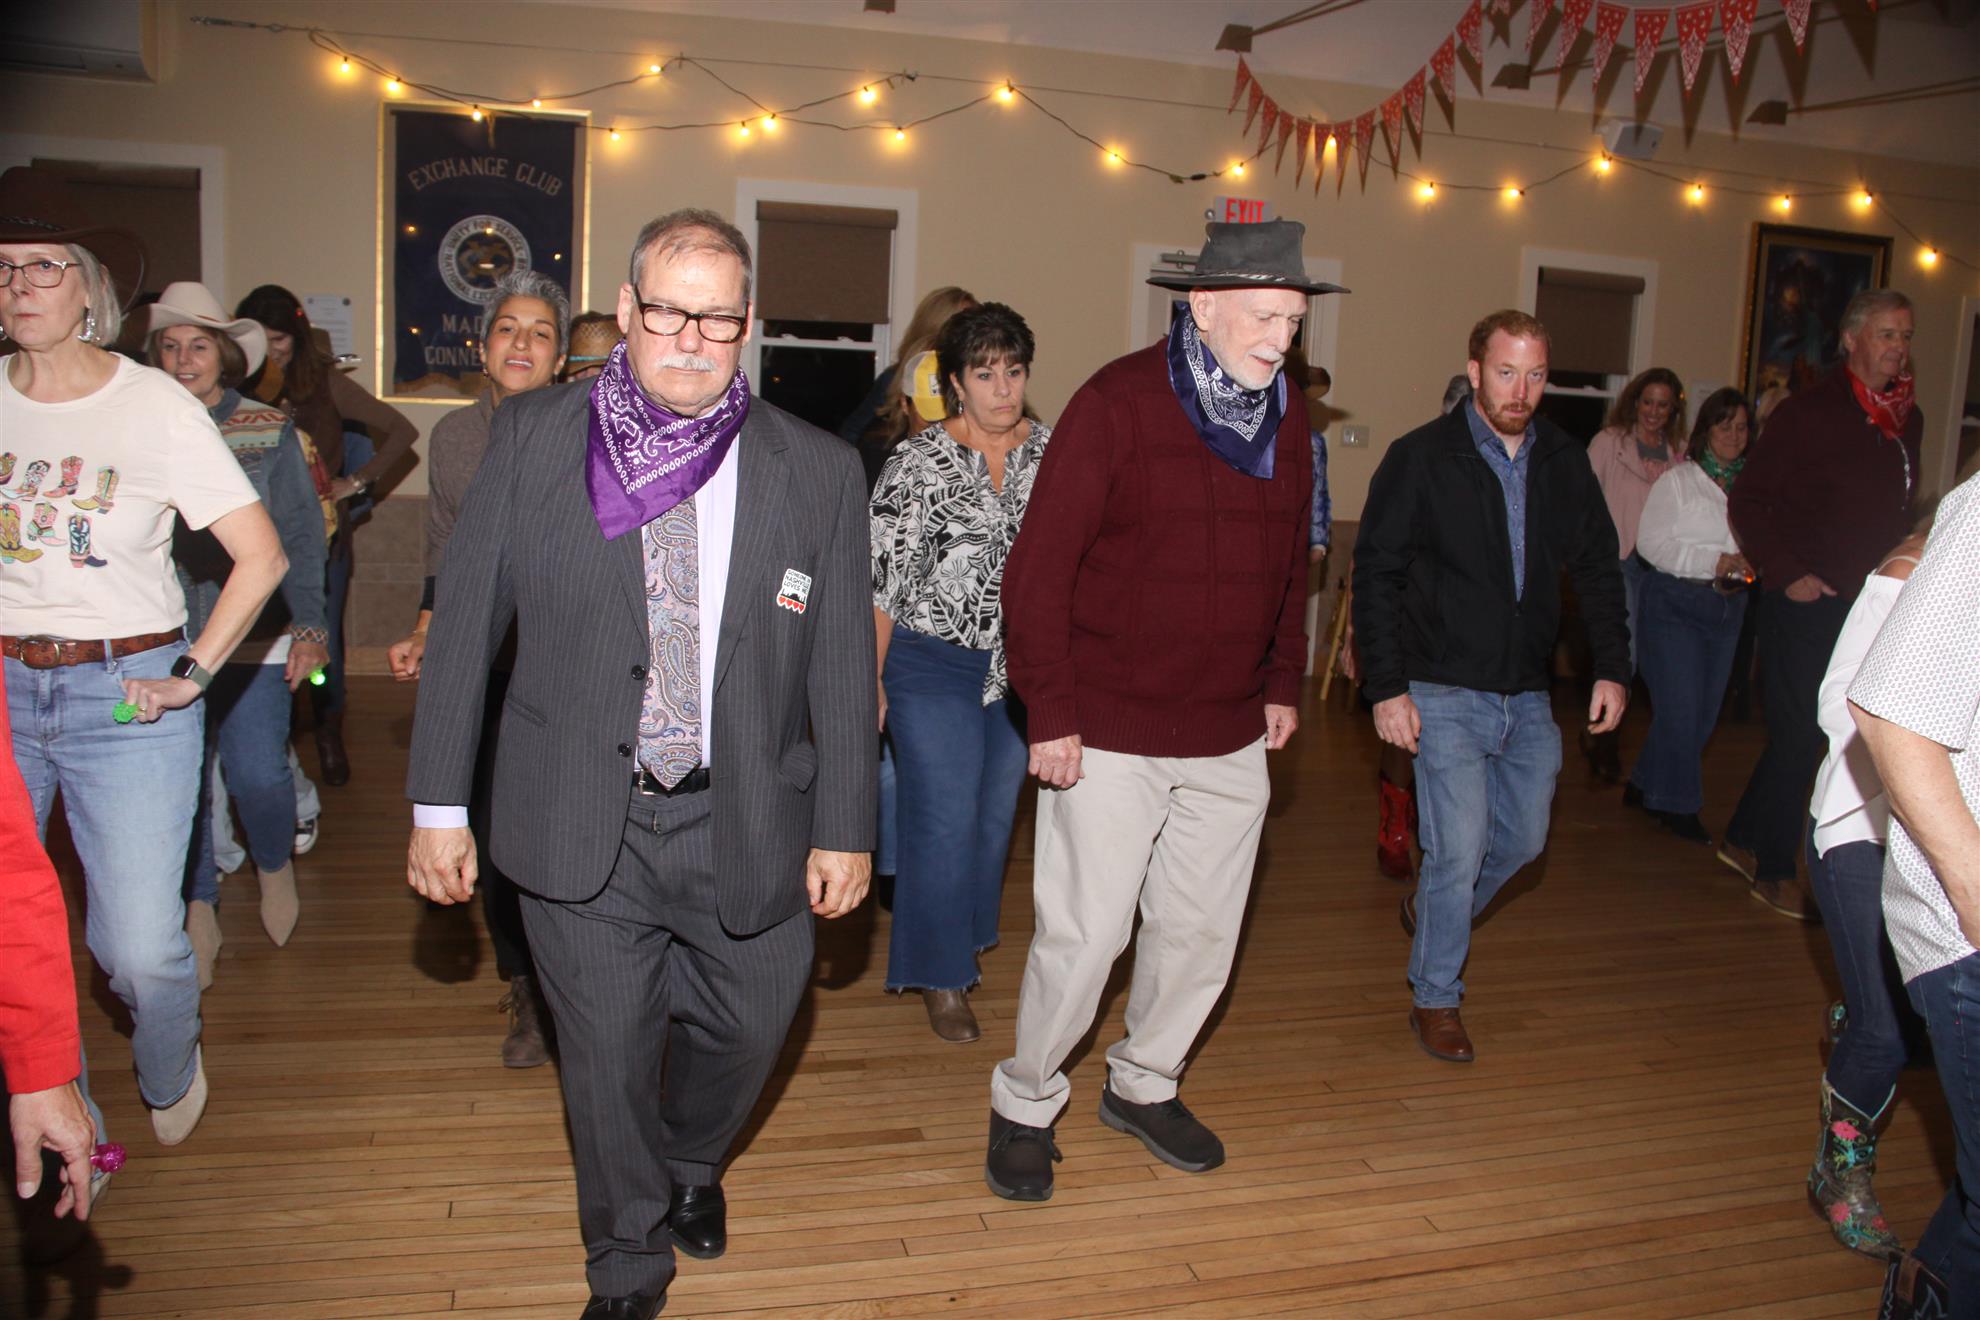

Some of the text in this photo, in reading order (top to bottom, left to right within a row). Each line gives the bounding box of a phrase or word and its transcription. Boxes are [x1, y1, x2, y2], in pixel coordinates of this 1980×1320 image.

[408, 156, 562, 196] EXCHANGE CLUB
[1226, 198, 1265, 224] EXIT
